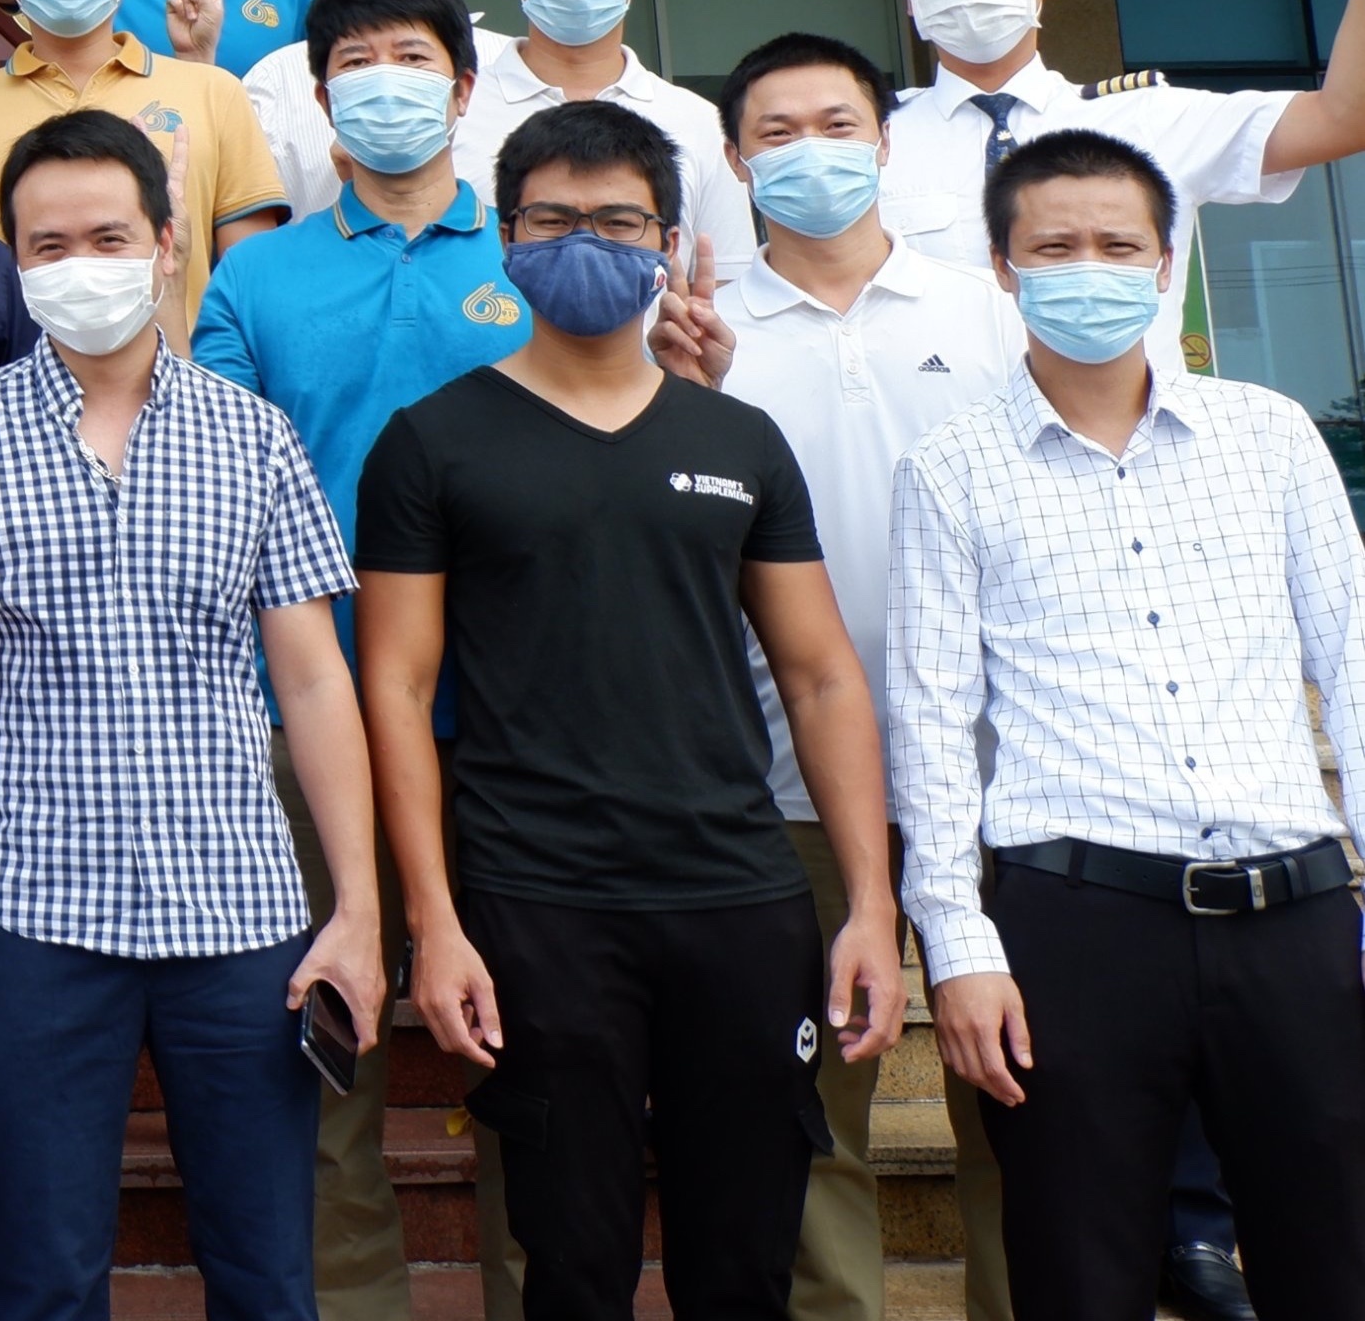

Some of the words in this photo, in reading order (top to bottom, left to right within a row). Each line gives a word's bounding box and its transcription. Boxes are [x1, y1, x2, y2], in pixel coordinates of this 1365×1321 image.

[918, 365, 951, 373] adidas
[694, 473, 744, 492] VIETNAM'S
[694, 483, 754, 505] SUPPLEMENTS
